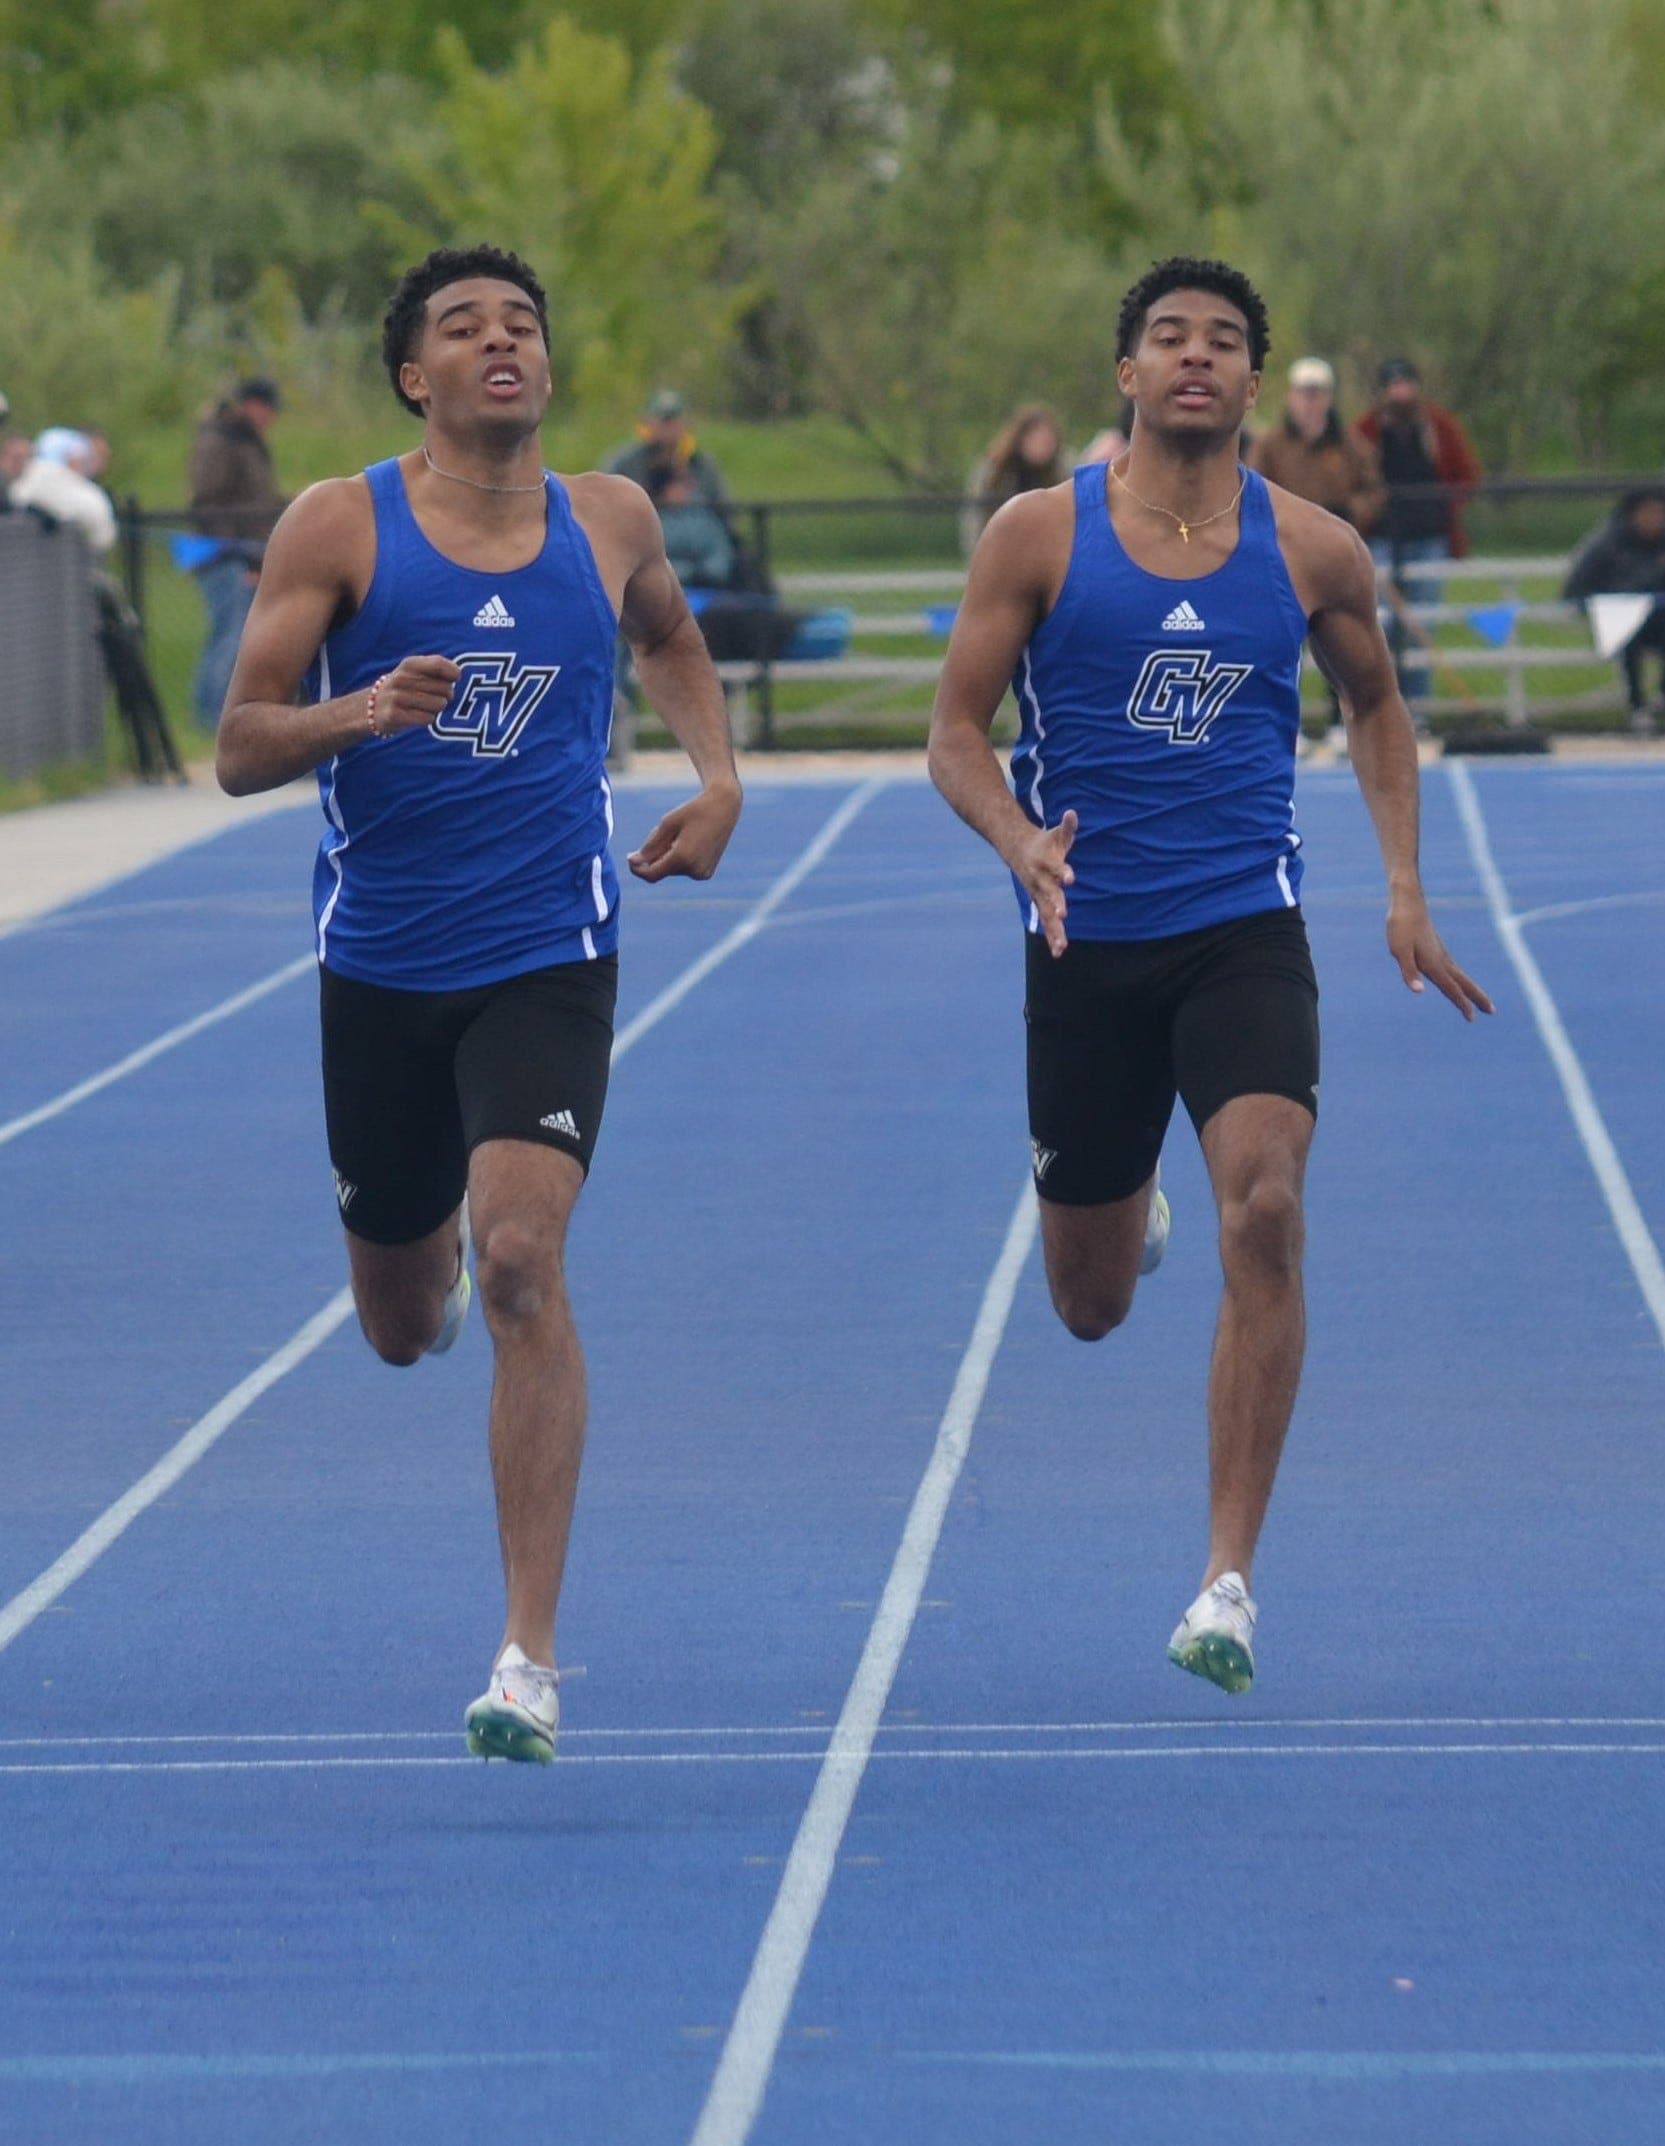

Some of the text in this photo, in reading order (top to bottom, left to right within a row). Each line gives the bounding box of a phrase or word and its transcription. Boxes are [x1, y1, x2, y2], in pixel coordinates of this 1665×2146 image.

[473, 615, 515, 628] adidas
[1162, 619, 1205, 631] adidas
[427, 652, 561, 758] GV
[1126, 649, 1255, 744] GV
[539, 1117, 580, 1140] adidas
